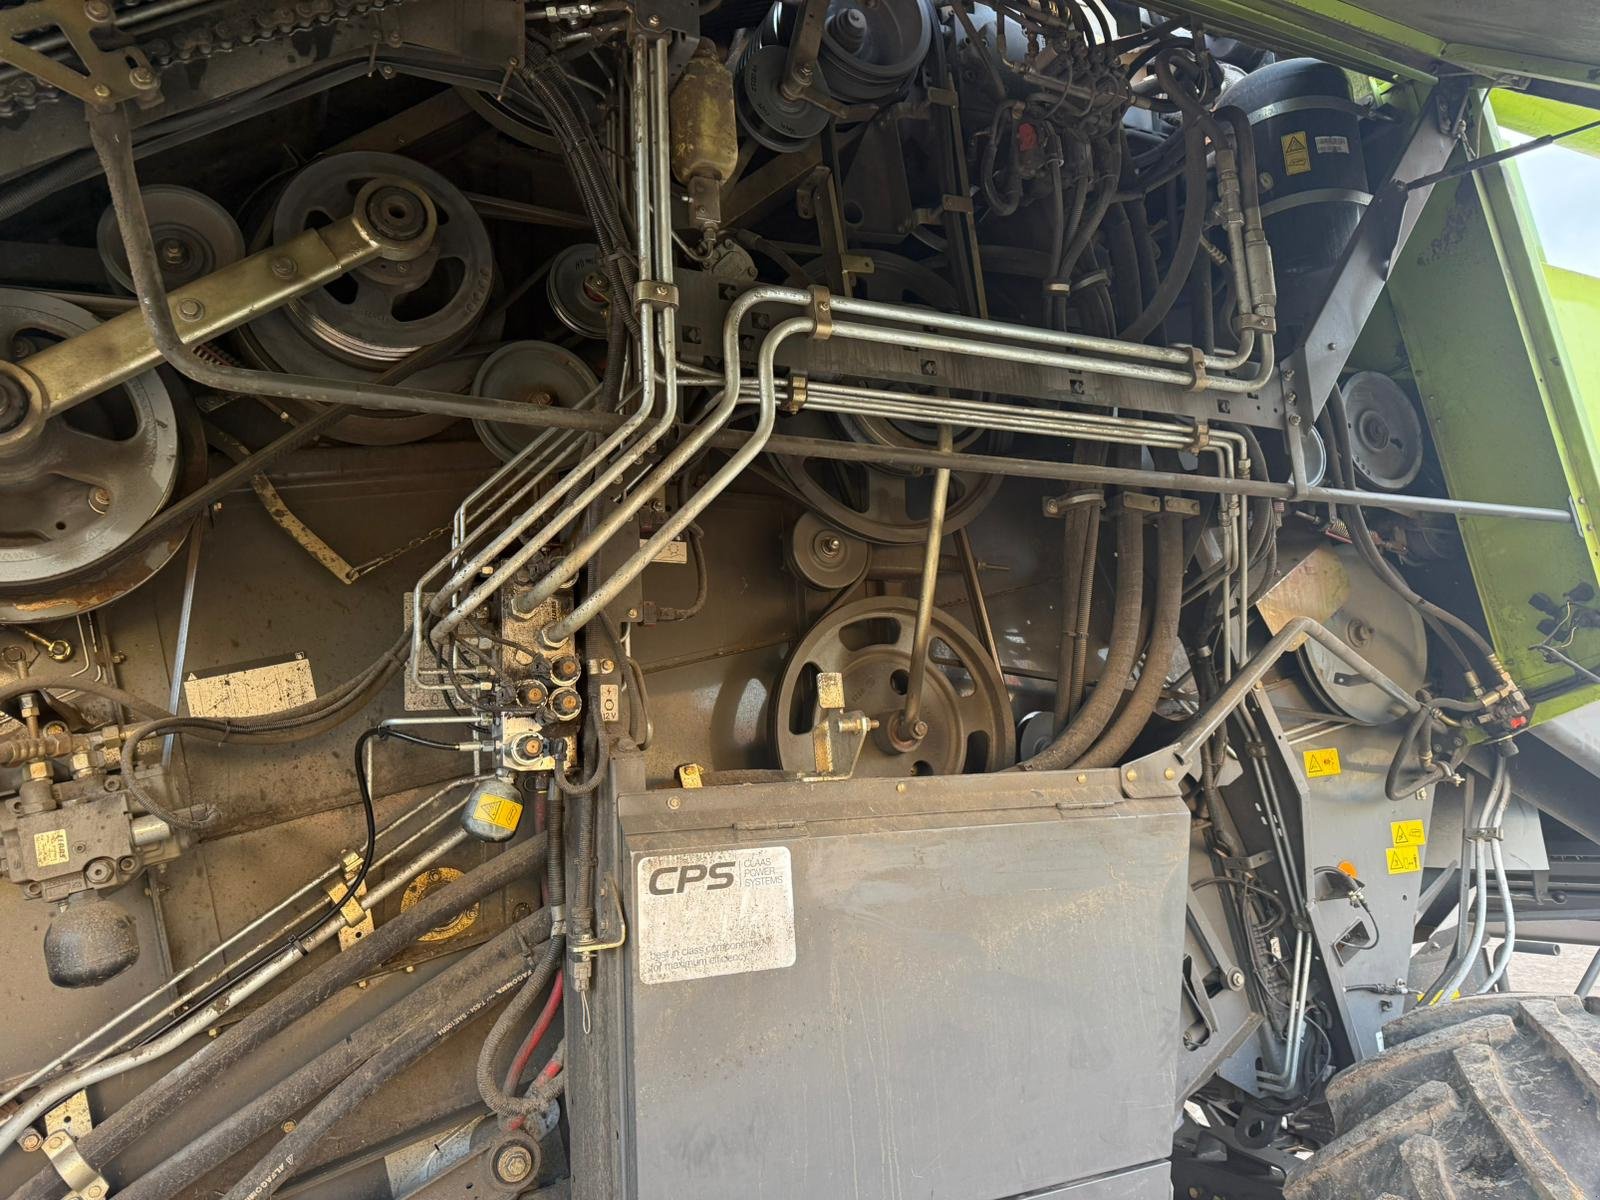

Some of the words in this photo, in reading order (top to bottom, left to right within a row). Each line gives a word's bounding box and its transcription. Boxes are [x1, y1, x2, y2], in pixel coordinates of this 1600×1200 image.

[743, 857, 772, 868] CLAAS
[744, 866, 776, 878] POWER
[648, 861, 736, 896] CPS
[744, 875, 784, 888] SYSTEMS
[681, 944, 705, 956] class
